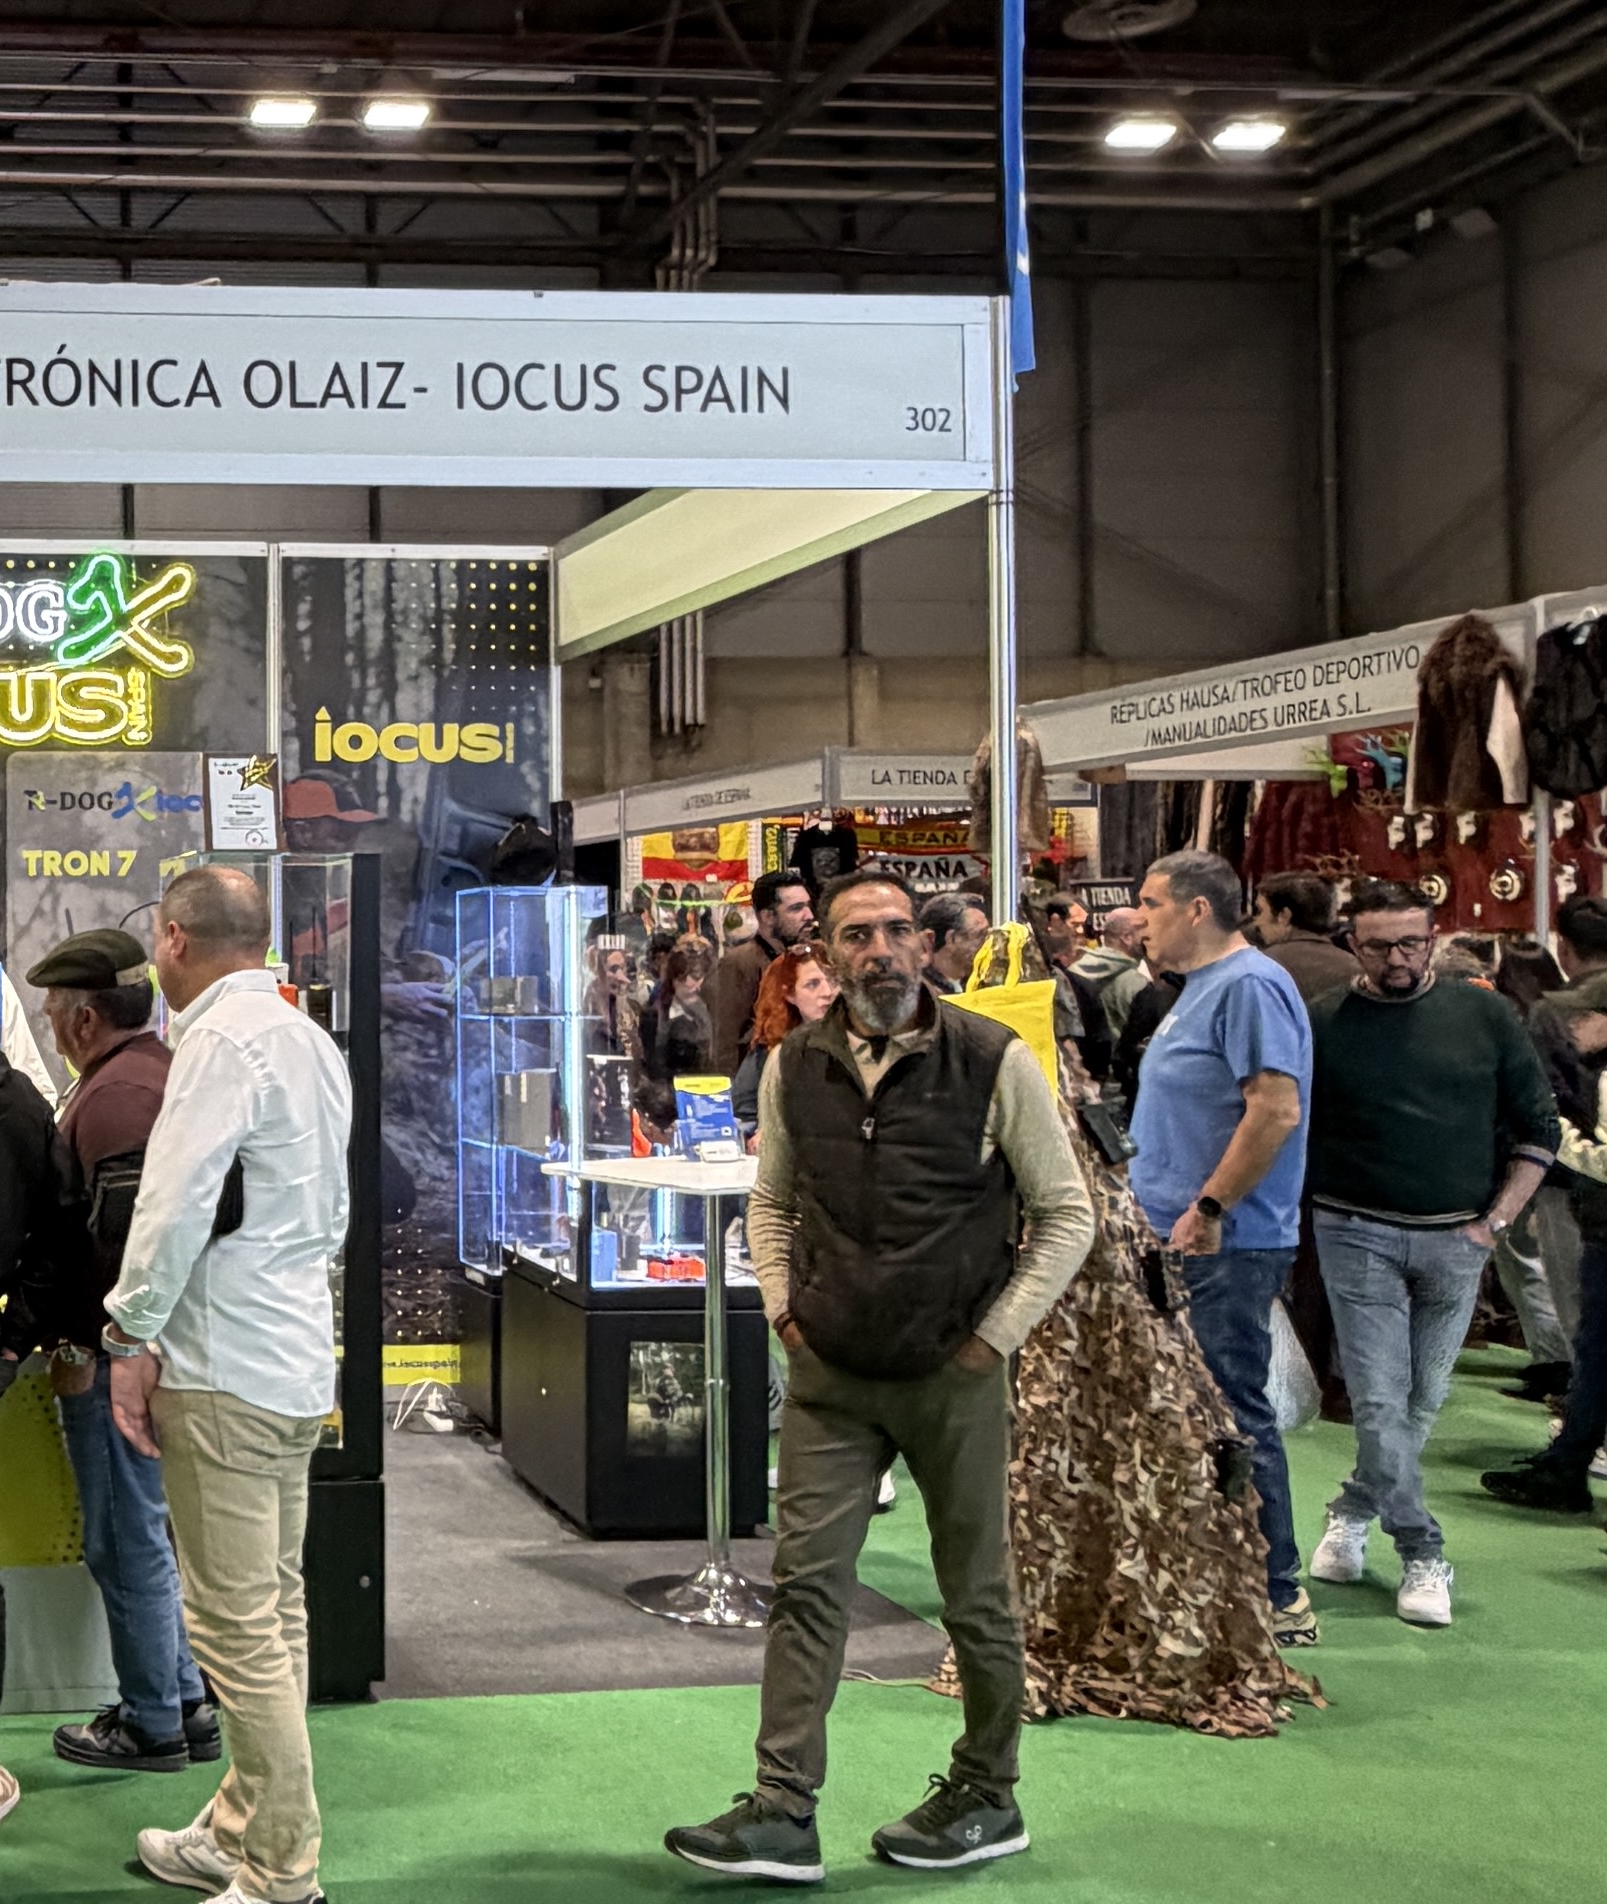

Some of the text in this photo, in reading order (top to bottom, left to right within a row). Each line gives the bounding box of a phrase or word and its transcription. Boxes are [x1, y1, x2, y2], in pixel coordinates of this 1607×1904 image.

[456, 362, 620, 413] IOCUS
[642, 365, 790, 415] SPAIN
[905, 406, 952, 433] 302
[1110, 693, 1175, 726] REPLICAS
[1312, 645, 1420, 688] DEPORTIVO
[1274, 698, 1331, 728] URREA
[1336, 691, 1372, 717] S.L.
[871, 770, 892, 785] LA
[897, 770, 958, 785] TIENDA
[22, 849, 110, 877] TRON
[117, 850, 137, 877] 7
